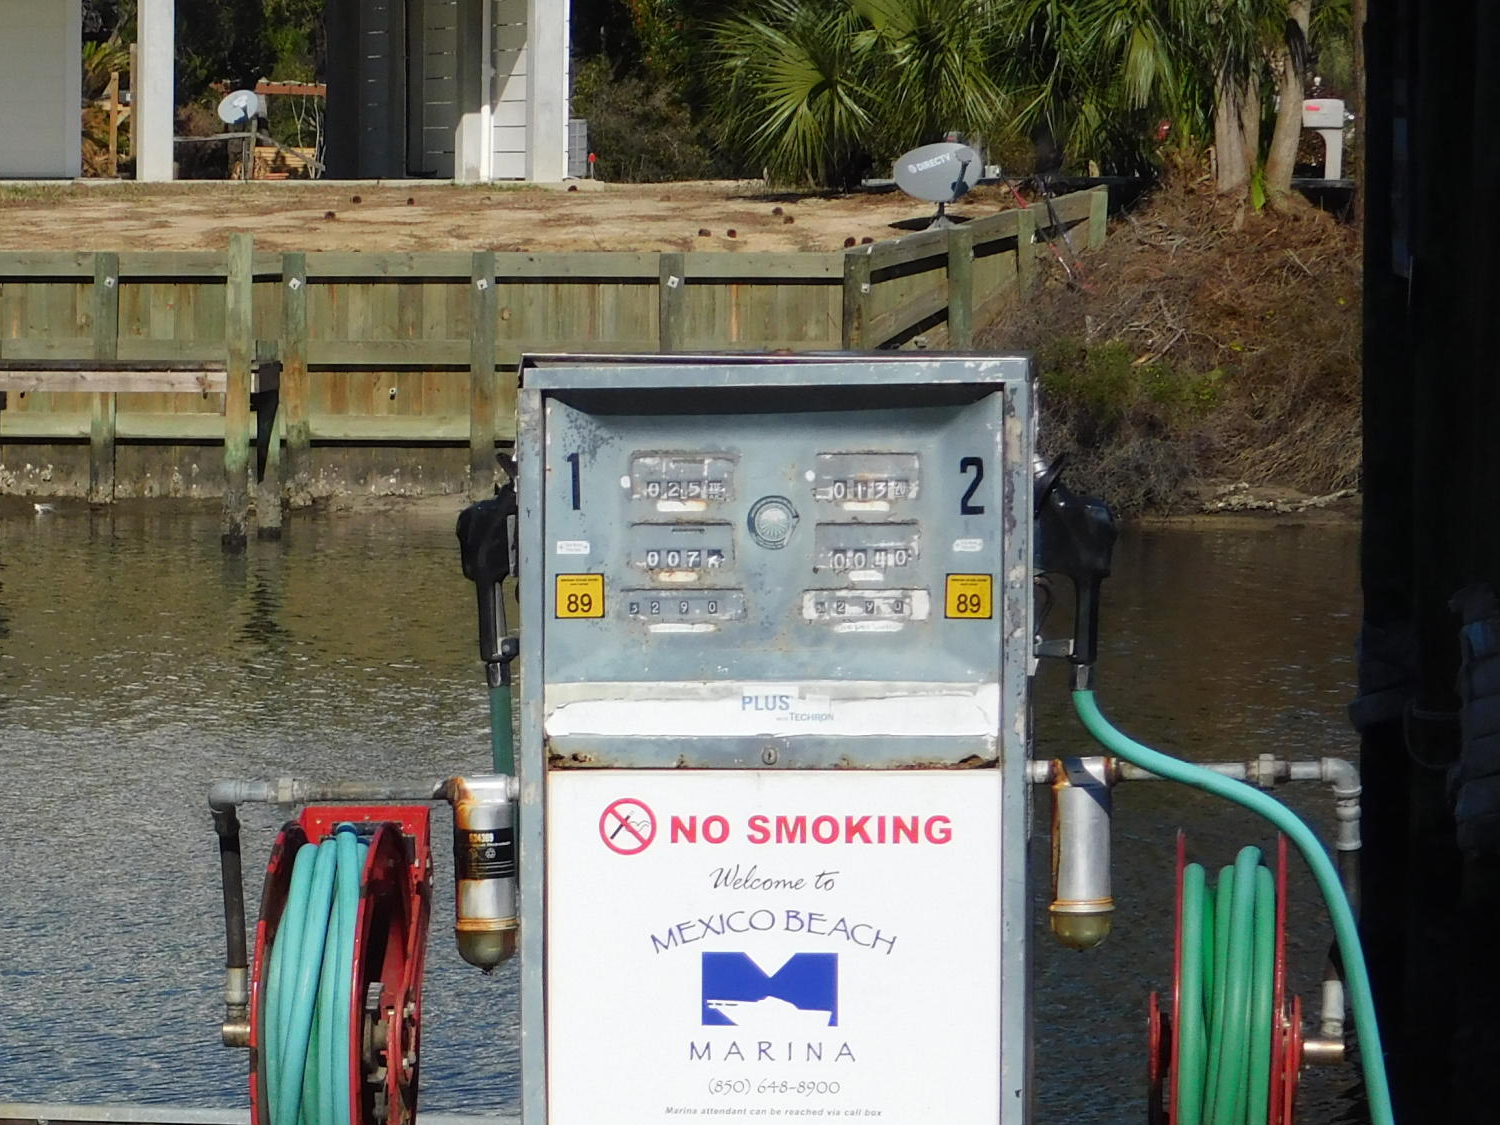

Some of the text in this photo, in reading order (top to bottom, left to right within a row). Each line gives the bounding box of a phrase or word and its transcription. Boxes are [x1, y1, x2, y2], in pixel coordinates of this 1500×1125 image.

[916, 153, 950, 172] DIRECTV
[567, 453, 581, 510] 1
[960, 457, 985, 515] 2
[567, 594, 592, 613] 89
[957, 594, 981, 613] 89
[741, 695, 790, 711] PLUS
[671, 815, 952, 844] NO SMOKING
[710, 864, 839, 891] Welcome to
[651, 910, 896, 956] MEXICO BEACH
[690, 1041, 855, 1062] MARINA
[709, 1079, 840, 1097] (850) 648-8900
[701, 1107, 746, 1115] attendant
